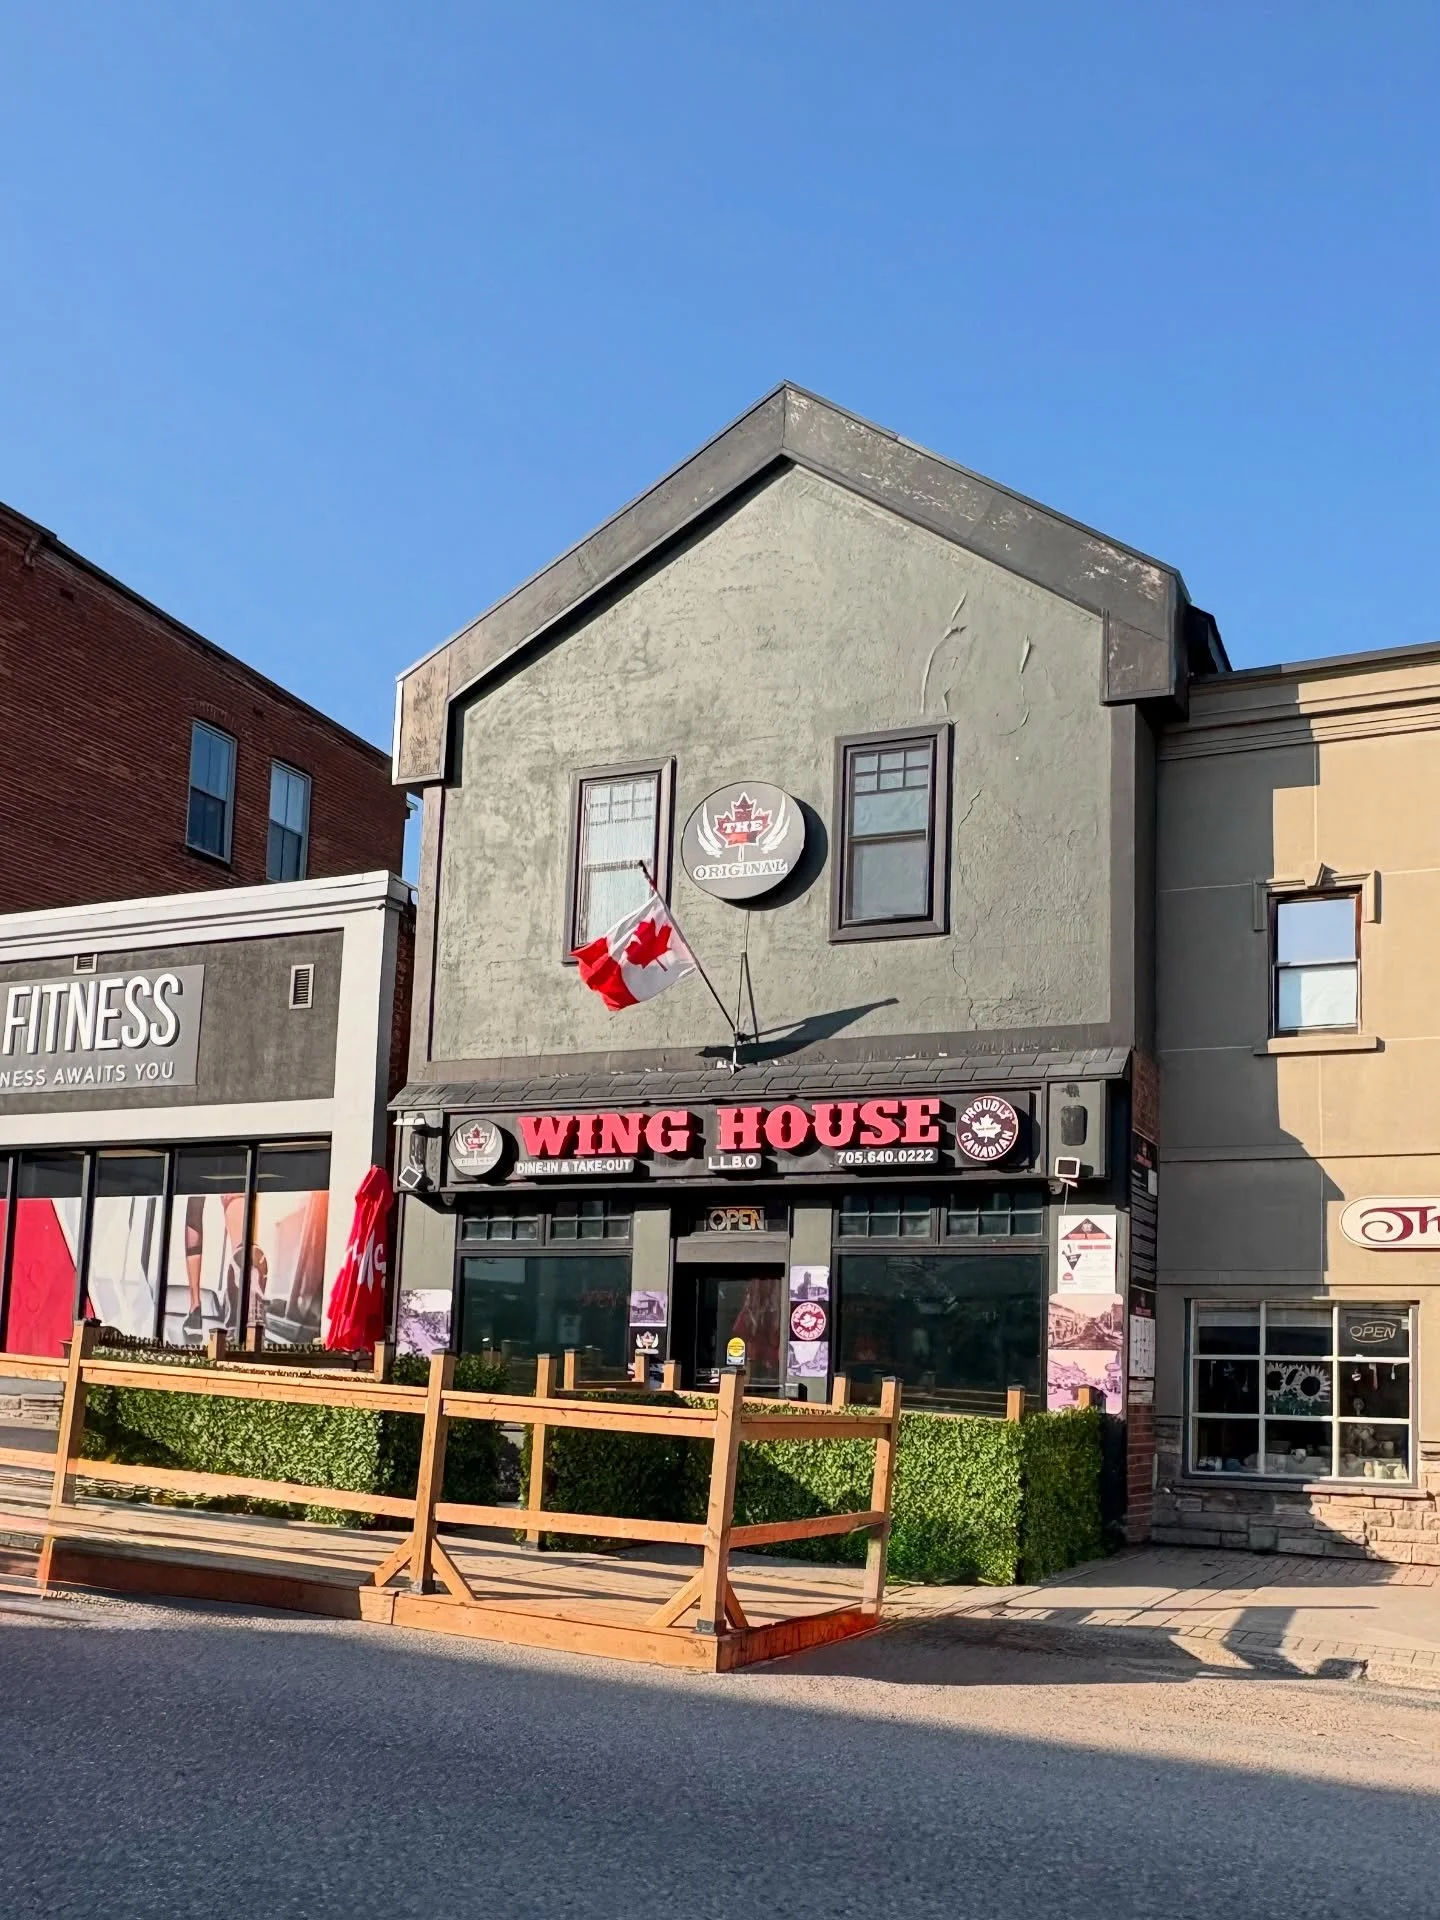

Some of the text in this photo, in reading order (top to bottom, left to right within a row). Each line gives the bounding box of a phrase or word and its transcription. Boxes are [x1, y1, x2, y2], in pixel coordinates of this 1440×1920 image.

[723, 820, 764, 834] THE
[694, 859, 787, 879] ORIGINAL
[2, 973, 182, 1055] FITNESS
[53, 1064, 127, 1085] AWAITS
[134, 1061, 175, 1081] YOU
[960, 1098, 1014, 1125] PROUDLY
[519, 1099, 940, 1156] WING HOUSE
[960, 1130, 1014, 1158] CANADIAN
[516, 1159, 632, 1175] DINE-IN & TAKE-OUT
[837, 1150, 935, 1164] 705.640.0222
[708, 1209, 765, 1231] OPEN
[1349, 1326, 1396, 1340] OPEN
